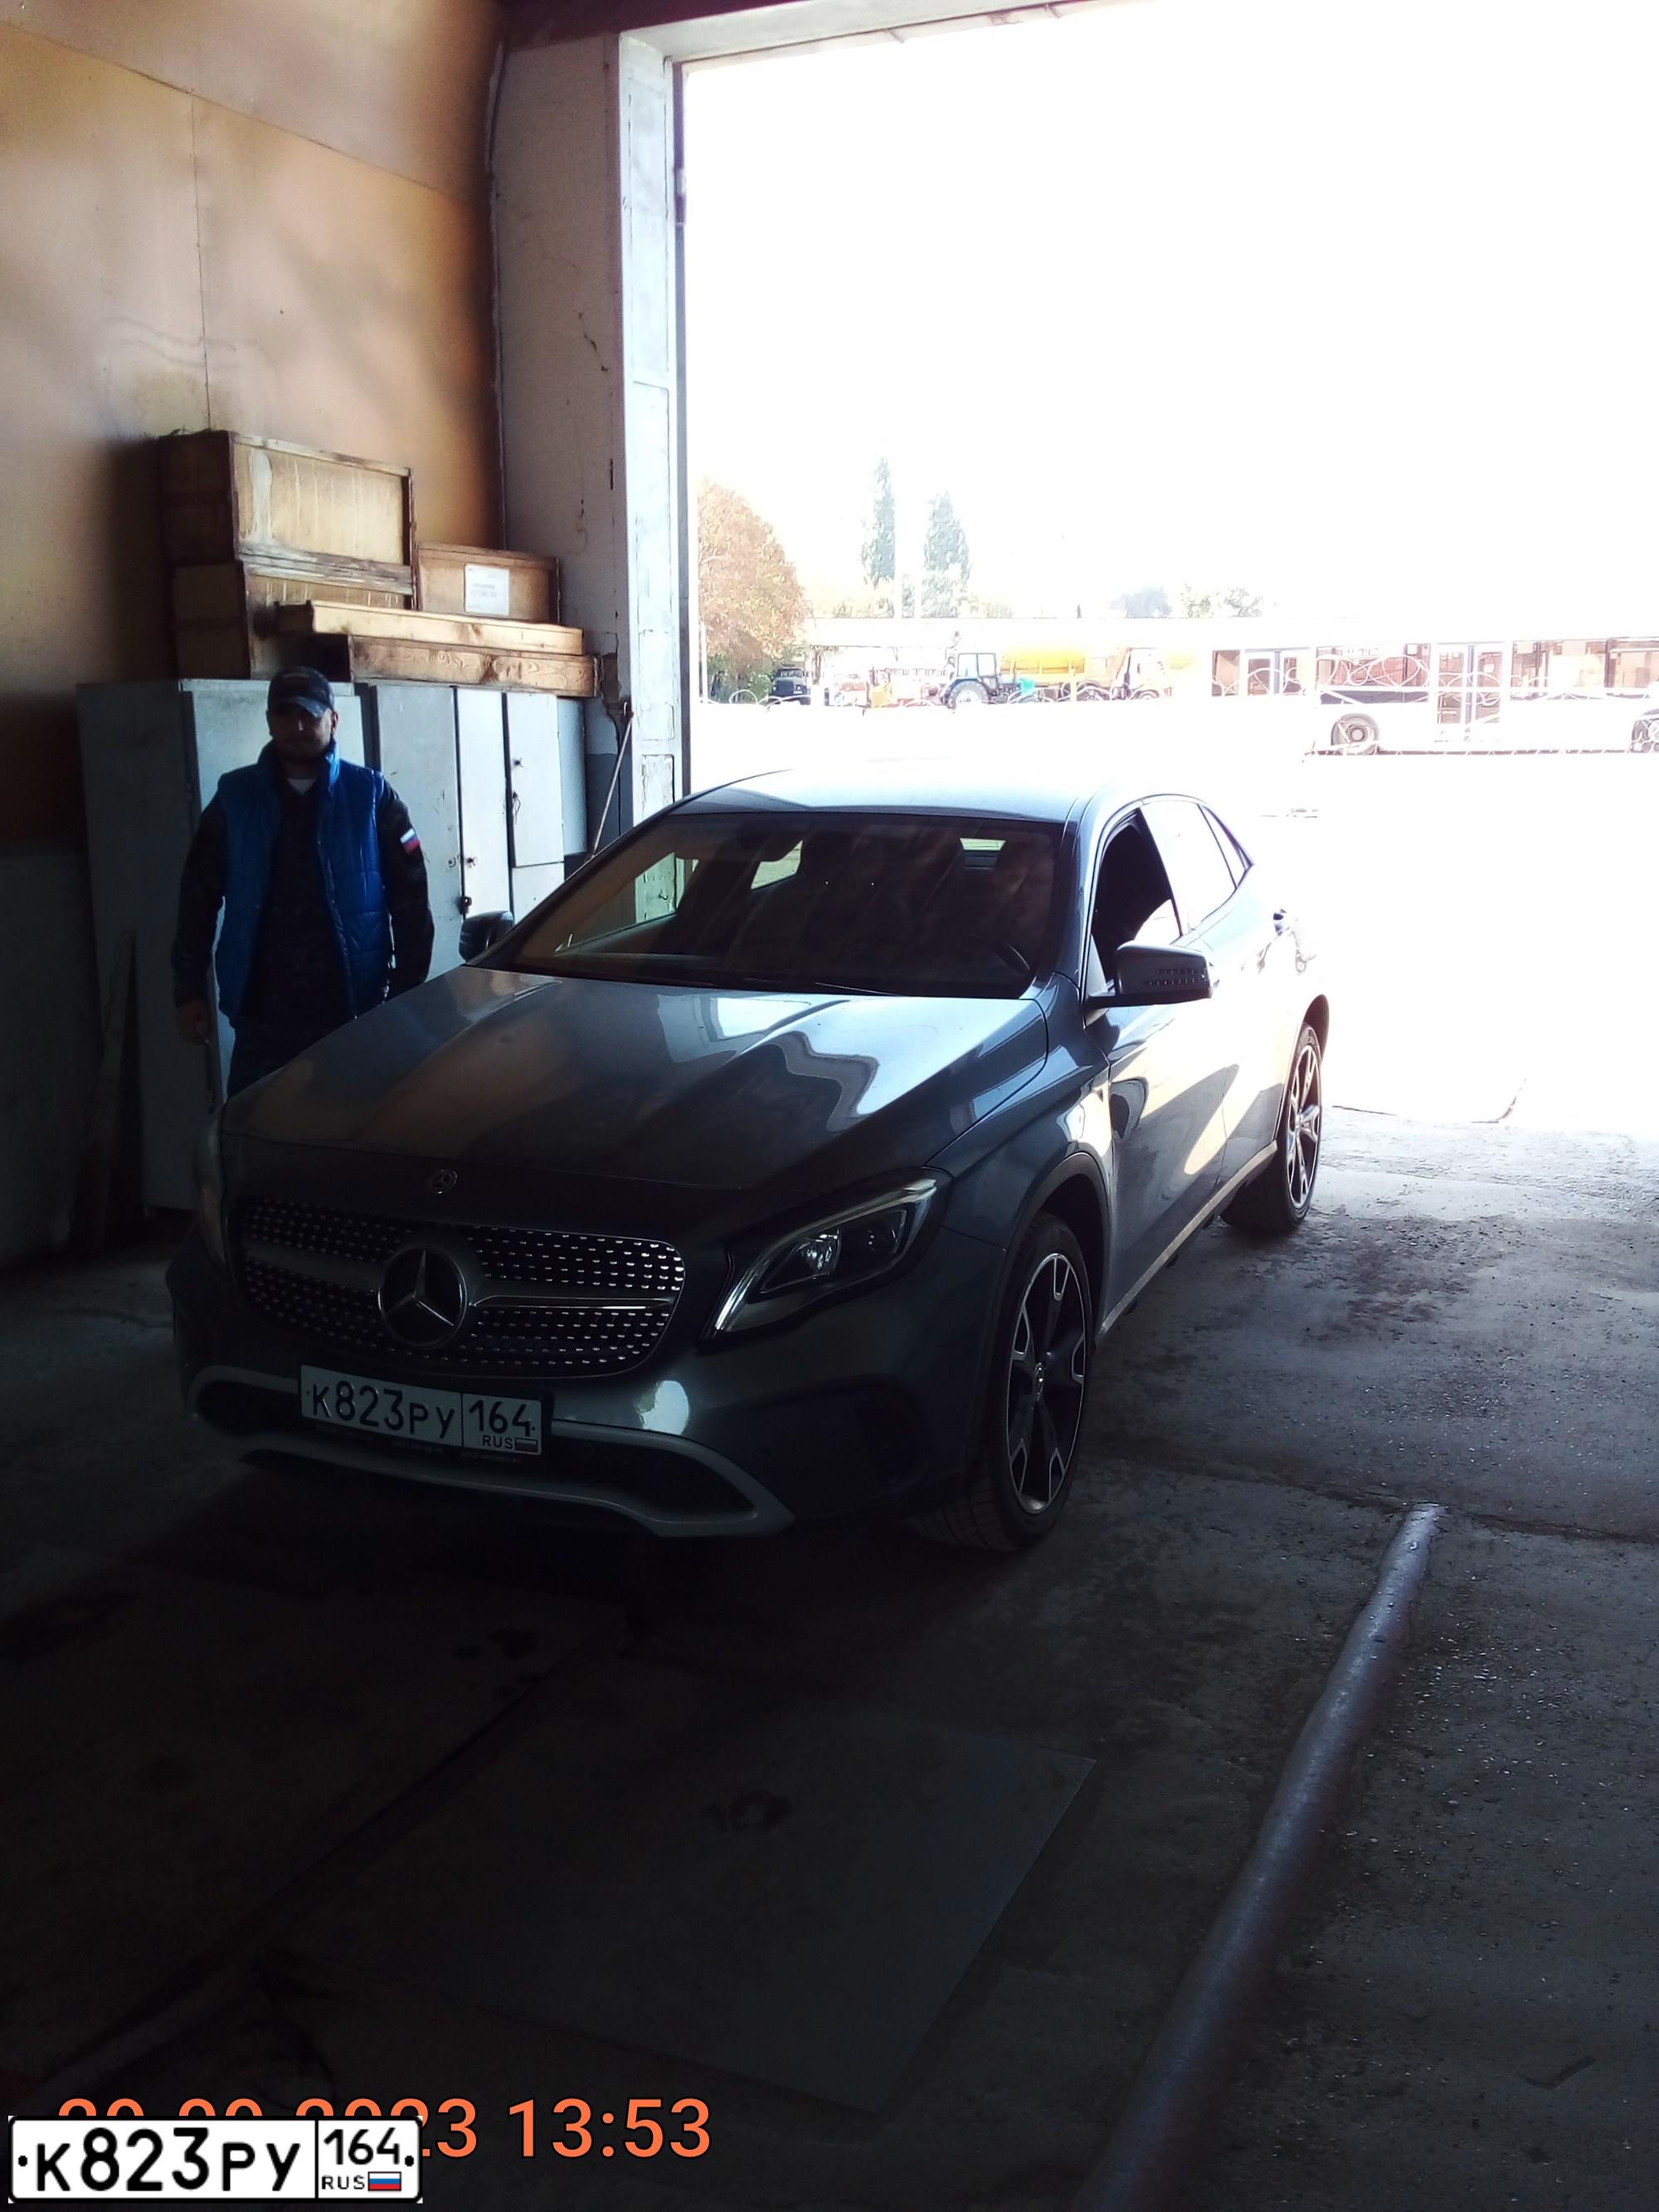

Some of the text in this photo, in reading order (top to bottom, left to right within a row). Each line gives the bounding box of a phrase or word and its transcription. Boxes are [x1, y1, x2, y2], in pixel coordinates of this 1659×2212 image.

[312, 1380, 532, 1439] К823РУ 164
[481, 1435, 513, 1449] RUS
